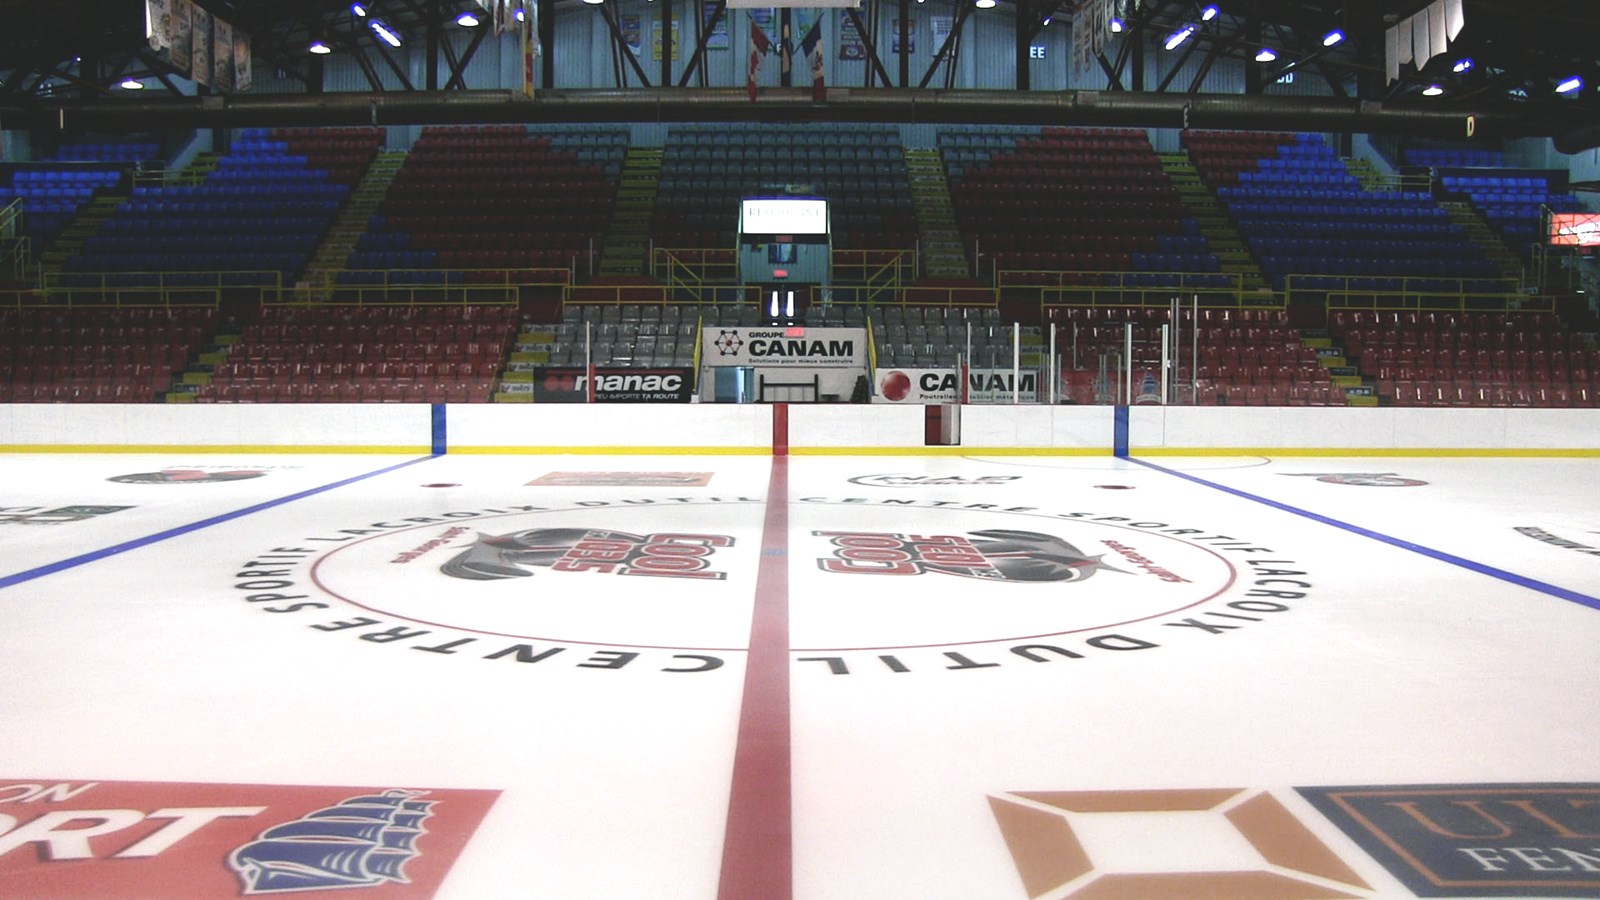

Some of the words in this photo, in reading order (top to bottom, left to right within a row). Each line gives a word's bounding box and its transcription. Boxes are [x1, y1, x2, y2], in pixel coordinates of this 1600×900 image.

[1029, 46, 1045, 58] EE
[748, 331, 785, 339] GROUPE
[748, 340, 854, 357] CANAM
[574, 374, 682, 392] manac
[919, 373, 1034, 392] CANAM
[653, 392, 680, 400] ROUTE
[575, 496, 761, 506] DUTIL
[799, 496, 1039, 513] CENTRE
[306, 504, 549, 542] LACROIX
[1057, 511, 1276, 555] SPORTIF
[235, 546, 331, 614] SPORTIF
[1162, 558, 1312, 635] LACROIX
[310, 616, 725, 674] CENTRE
[797, 633, 1160, 676] DUTIL
